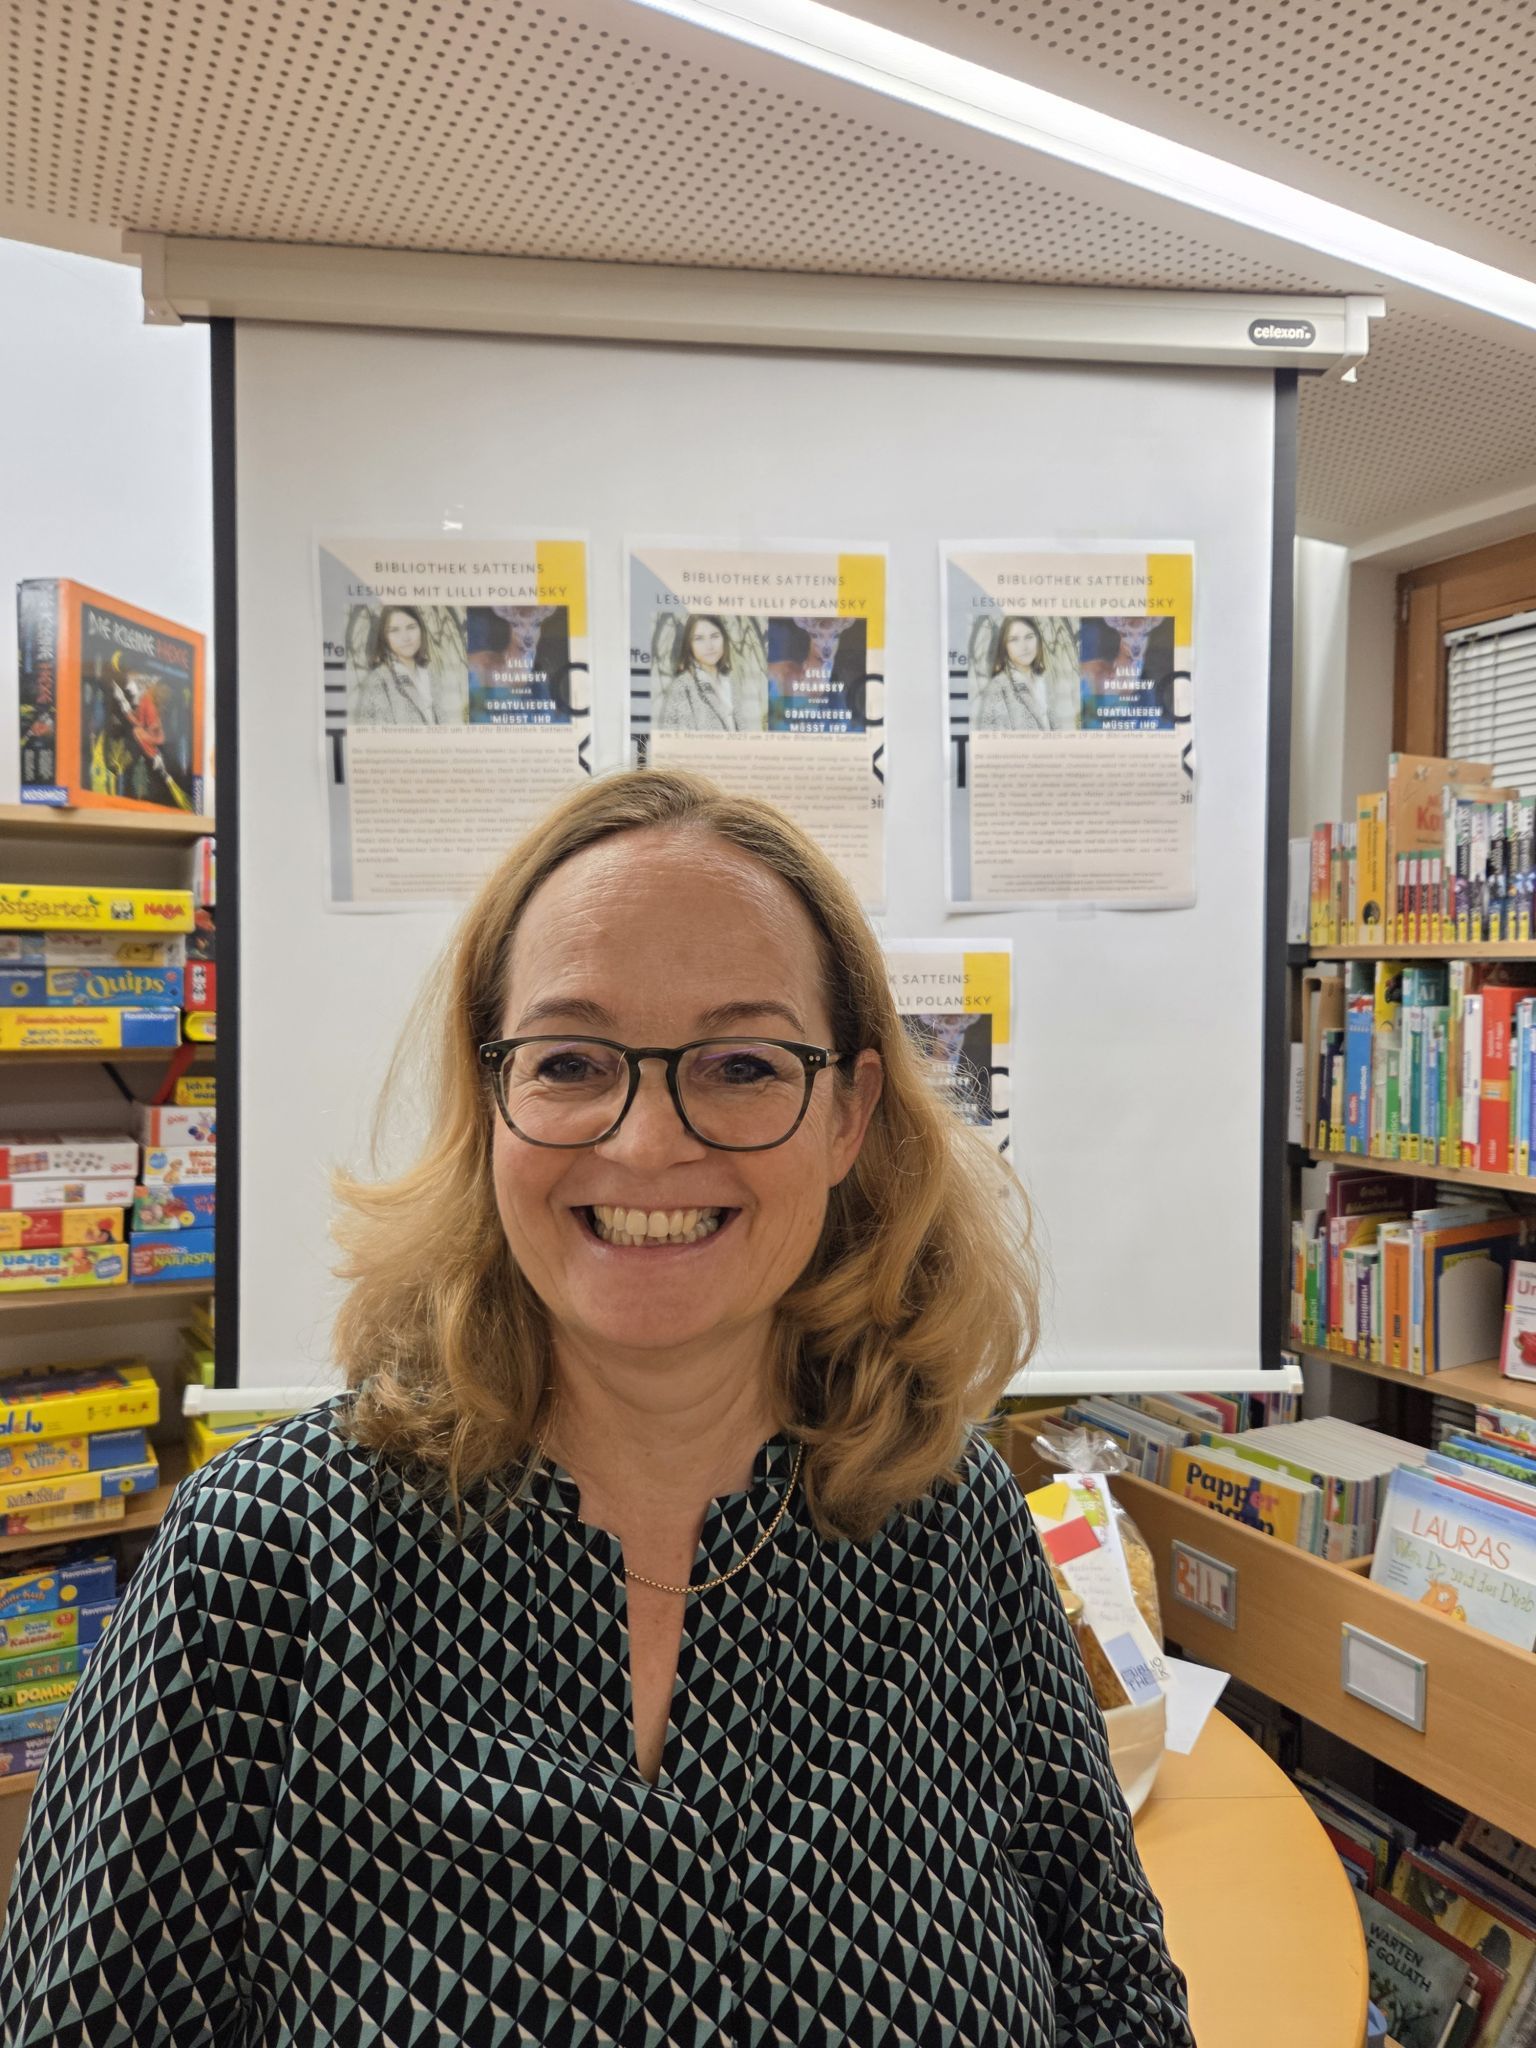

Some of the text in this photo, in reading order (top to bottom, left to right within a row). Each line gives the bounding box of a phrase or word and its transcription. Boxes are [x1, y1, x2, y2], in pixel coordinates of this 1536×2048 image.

[374, 562, 545, 574] BIBLIOTHEK SATTEINS
[682, 571, 845, 587] BIBLIOTHEK SATTEINS
[997, 574, 1154, 587] BIBLIOTHEK SATTEINS
[347, 585, 568, 598] LESUNG MIT LILLI POLANSKY
[656, 593, 867, 610] LESUNG MIT LILLI POLANSKY
[972, 596, 1176, 609] LESUNG MIT LILLI POLANSKY
[493, 672, 548, 683] POLANSKY
[487, 700, 557, 711] GRATULIEREN
[492, 712, 530, 724] MÜSST
[22, 788, 68, 802] KOSMOS
[86, 970, 166, 999] Quips
[902, 973, 970, 985] SATTEINS
[916, 996, 991, 1007] POLANSKY
[1411, 1507, 1512, 1571] LAURAS
[61, 1564, 113, 1580] Ravensburger
[1499, 1581, 1536, 1613] Dieb
[16, 1681, 77, 1706] DOMINO
[1370, 1921, 1424, 1968] WARTEN
[1376, 1946, 1433, 1993] GOLIATH
